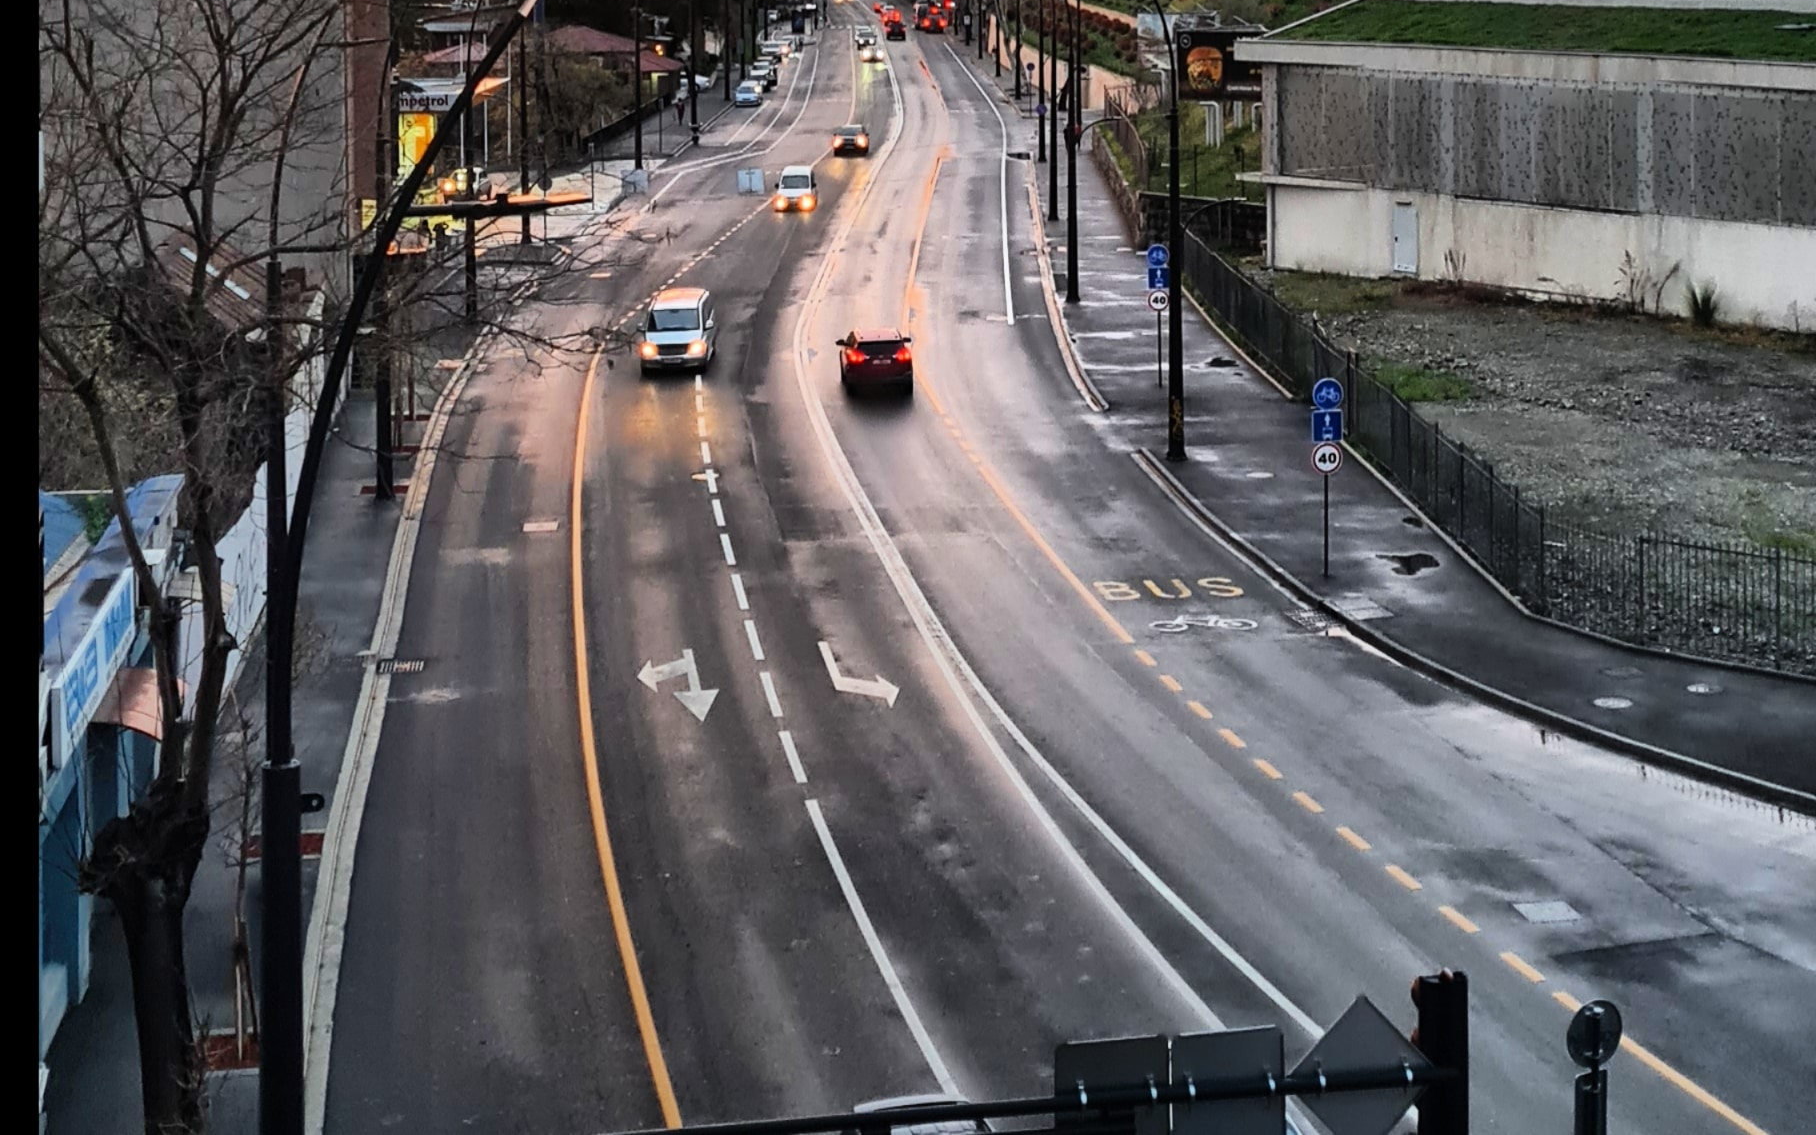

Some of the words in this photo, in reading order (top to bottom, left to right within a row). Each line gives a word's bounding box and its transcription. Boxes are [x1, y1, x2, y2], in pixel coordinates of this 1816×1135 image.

[399, 94, 449, 109] mpetrol
[1152, 296, 1166, 305] 40
[1318, 452, 1337, 464] 40
[1093, 576, 1244, 601] BUS
